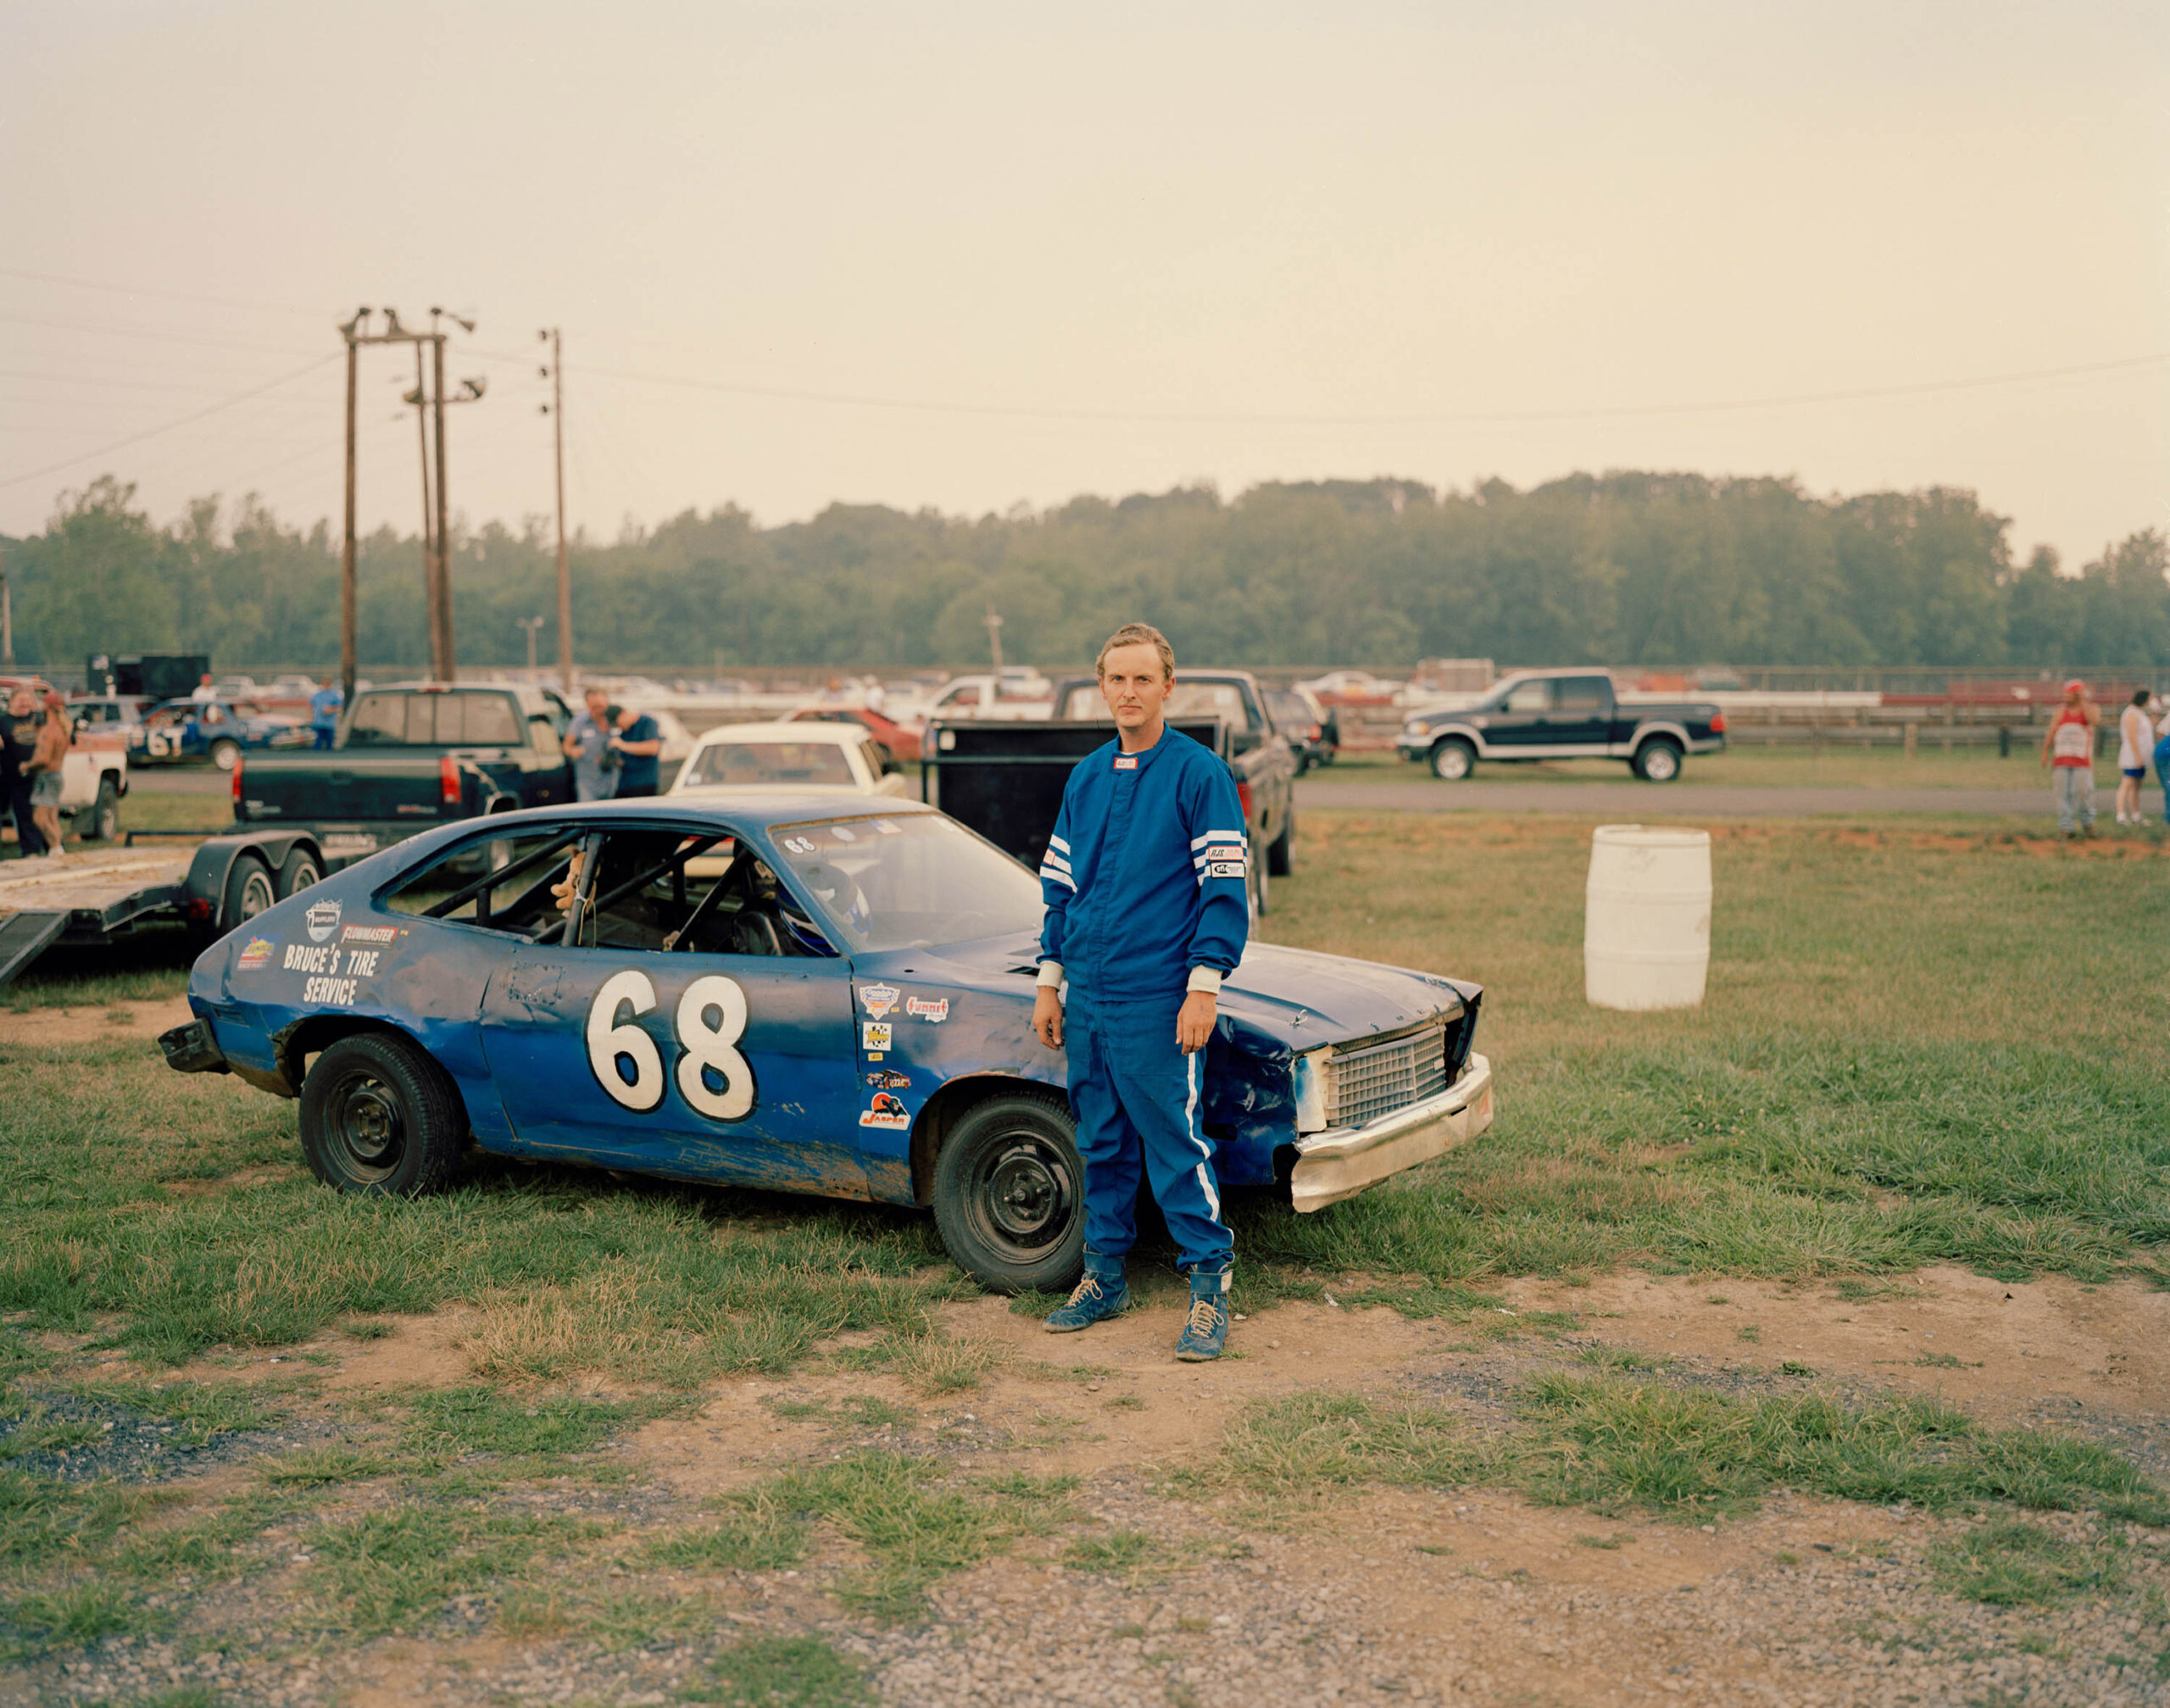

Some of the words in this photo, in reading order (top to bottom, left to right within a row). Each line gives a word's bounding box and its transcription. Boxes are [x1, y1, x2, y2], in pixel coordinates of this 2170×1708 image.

[784, 836, 815, 854] 68
[340, 926, 395, 943] FLOWMASTER
[283, 943, 341, 975] BRUCE'S
[347, 950, 380, 977] TIRE
[303, 976, 358, 1006] SERVICE
[586, 969, 757, 1121] 68
